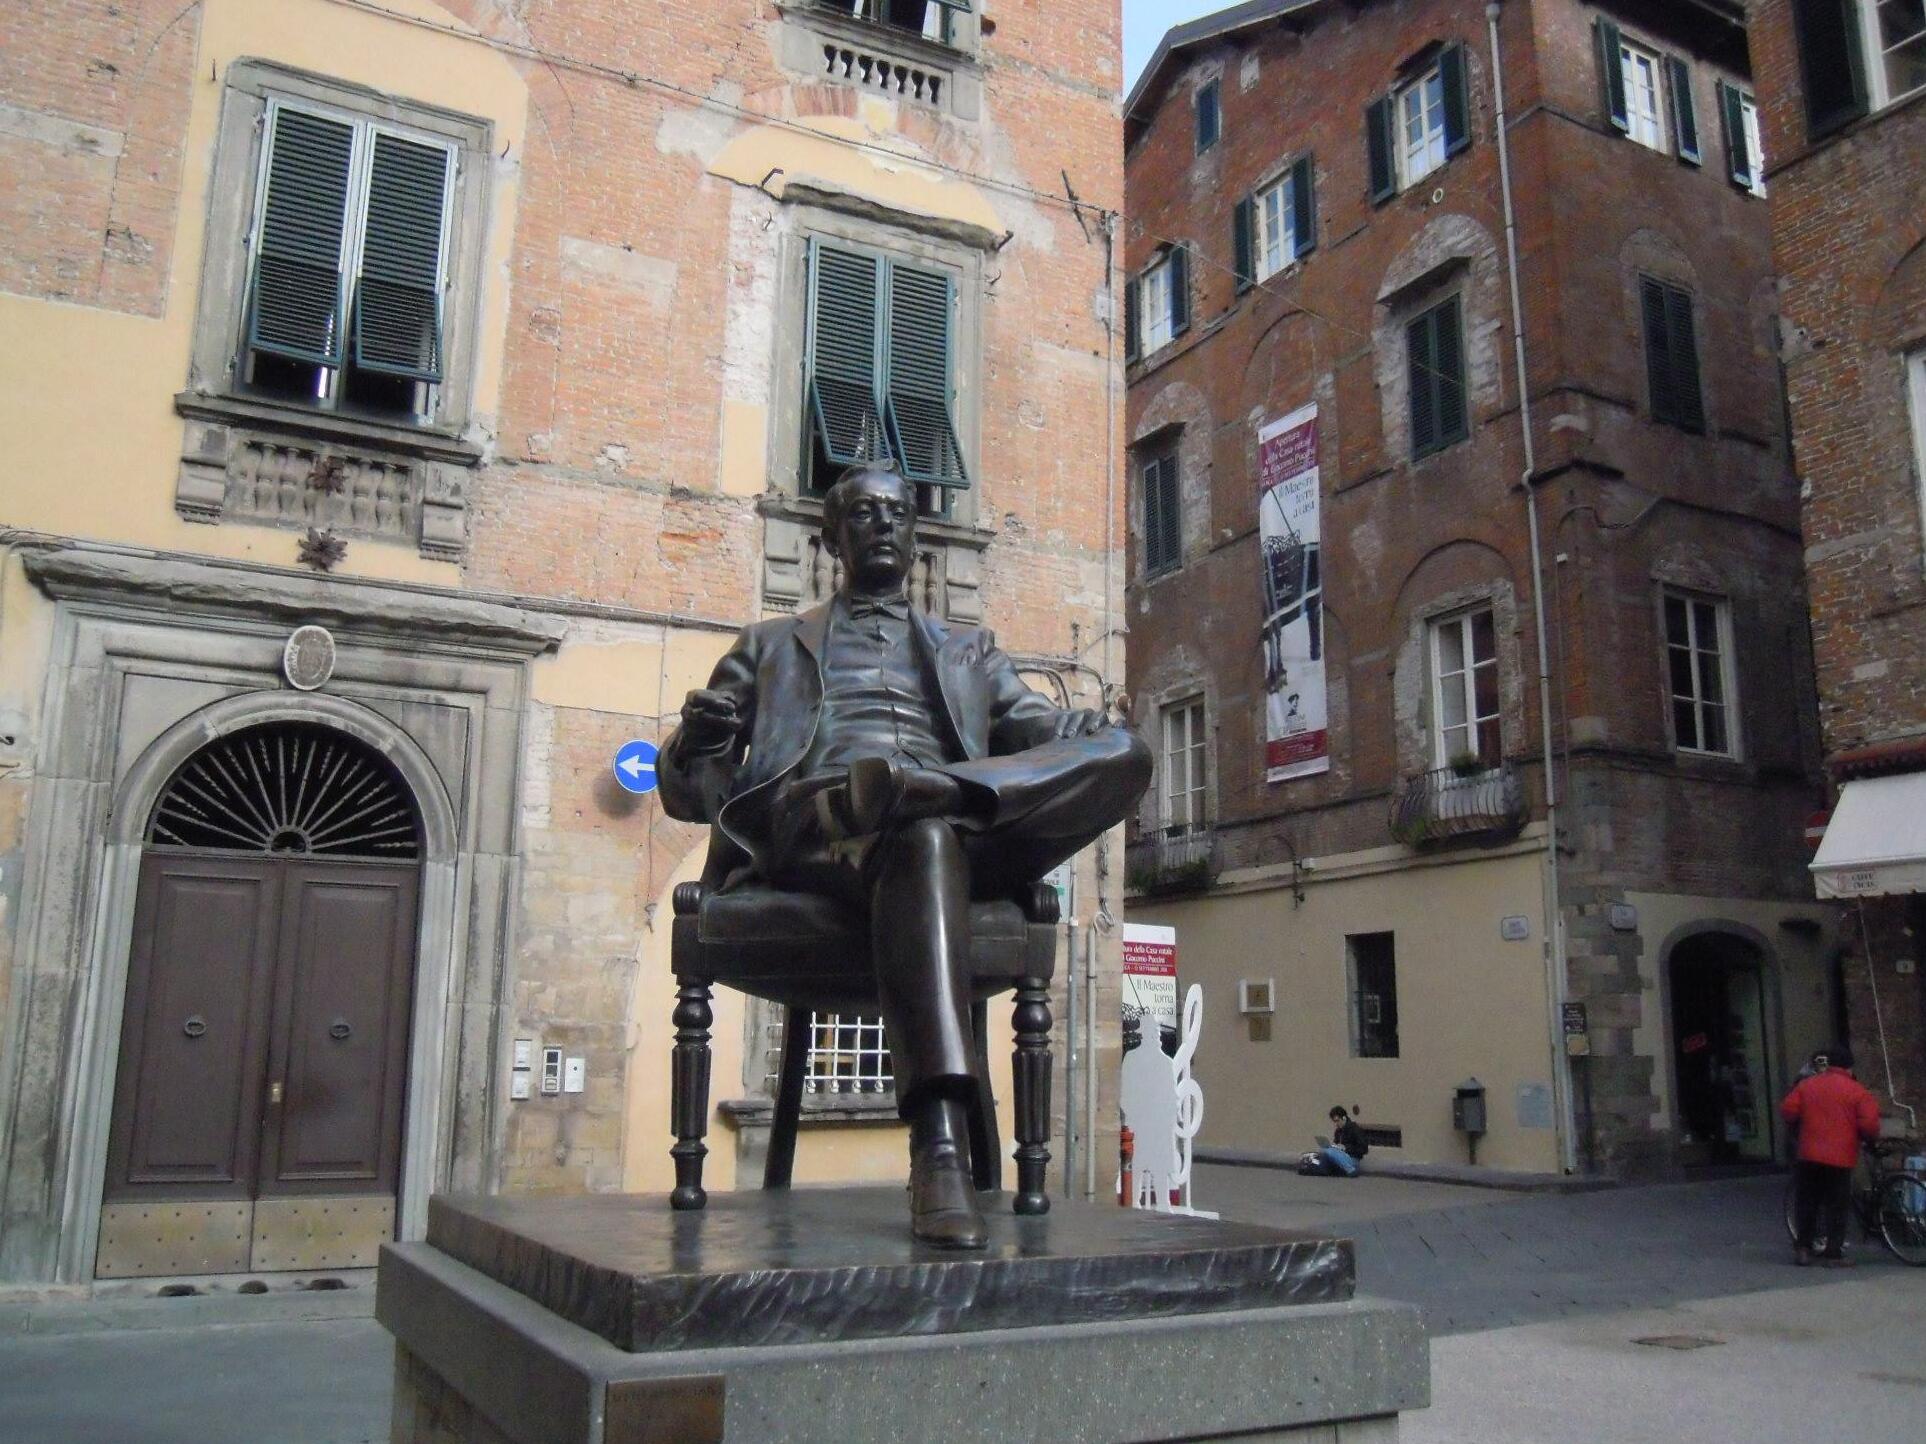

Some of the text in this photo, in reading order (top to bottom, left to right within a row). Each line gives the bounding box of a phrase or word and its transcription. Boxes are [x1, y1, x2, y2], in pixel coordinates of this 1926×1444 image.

[1146, 946, 1158, 954] Casa
[1143, 979, 1174, 992] Maestro
[1154, 993, 1174, 1004] torna
[1158, 1007, 1174, 1016] casa
